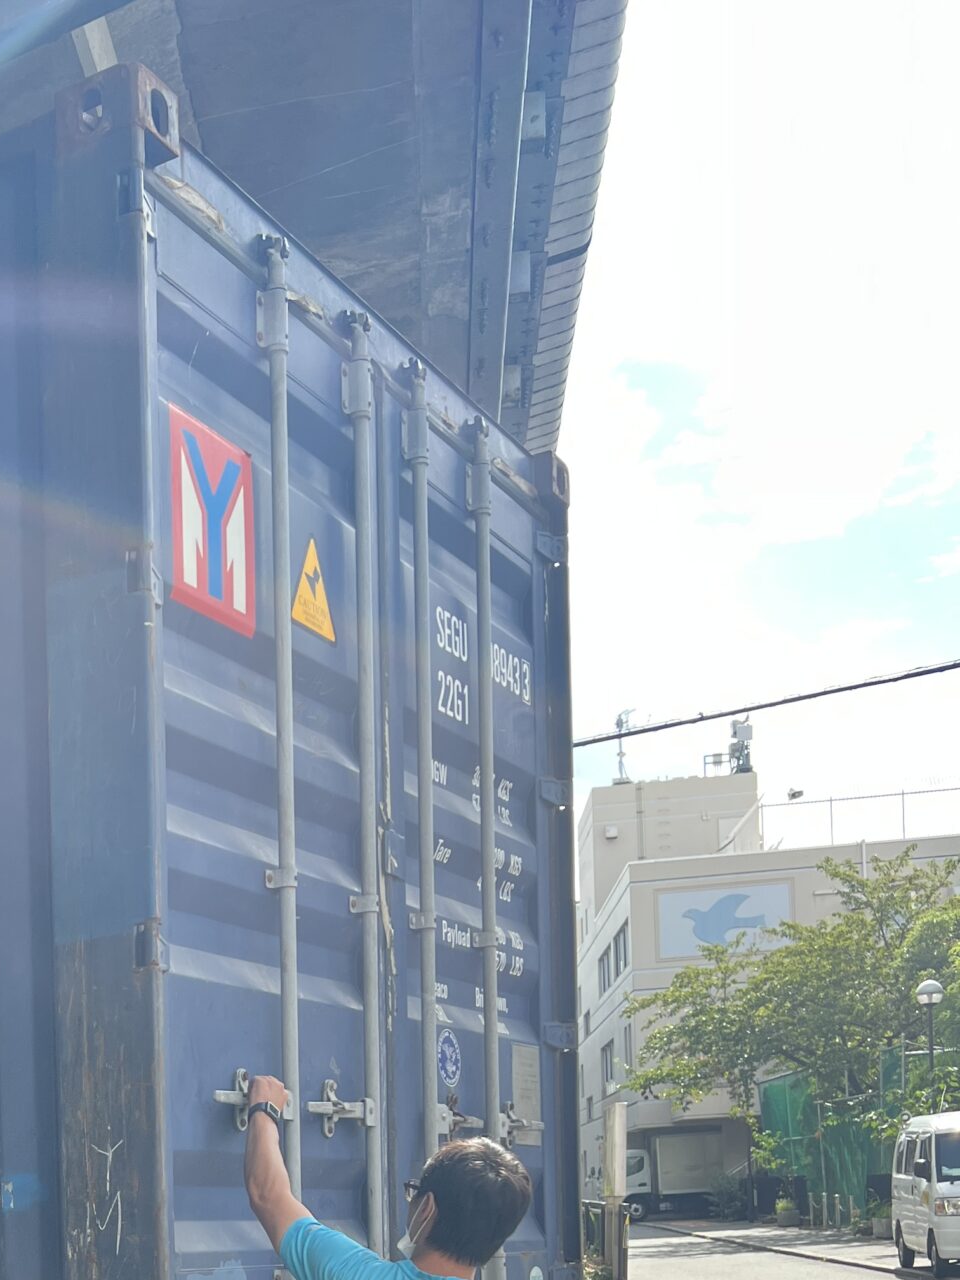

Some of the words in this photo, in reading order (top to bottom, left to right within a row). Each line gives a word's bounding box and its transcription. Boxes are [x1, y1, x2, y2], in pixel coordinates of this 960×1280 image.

[435, 605, 468, 663] SEGU
[437, 669, 469, 725] 22G1
[431, 760, 447, 786] GW
[433, 838, 451, 864] Tare
[442, 919, 471, 949] Payload
